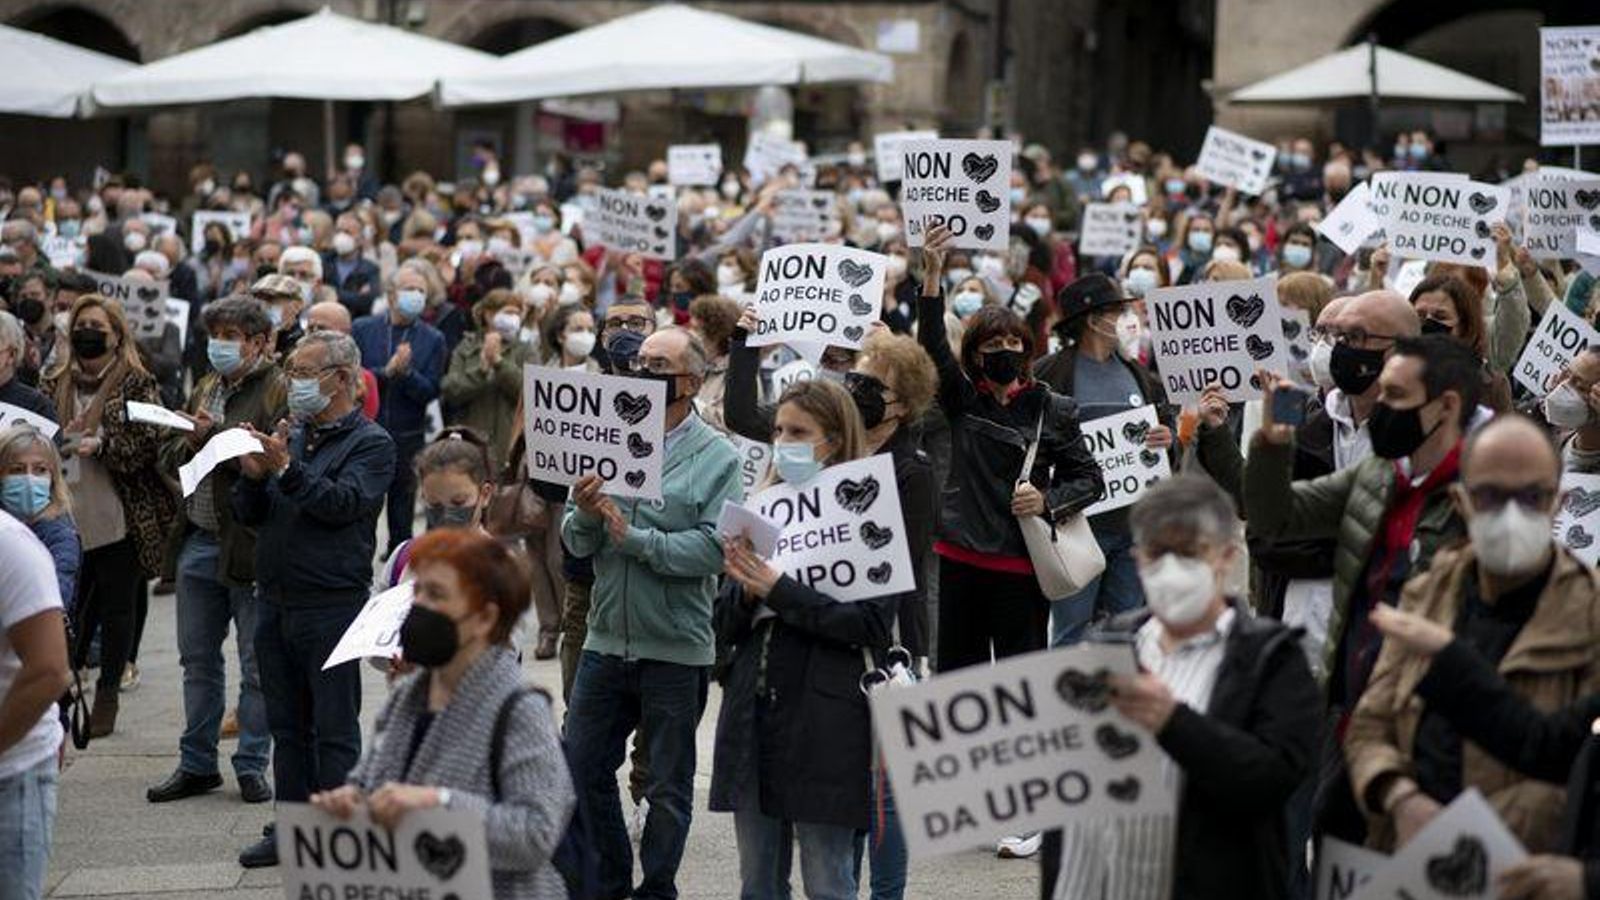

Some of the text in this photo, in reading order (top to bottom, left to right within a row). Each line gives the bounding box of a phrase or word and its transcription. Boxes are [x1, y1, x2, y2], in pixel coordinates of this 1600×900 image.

[905, 152, 951, 179] NON
[601, 194, 638, 217] NON
[921, 186, 970, 203] PECHE
[1404, 183, 1460, 209] NON
[1528, 187, 1567, 209] NON
[1400, 210, 1471, 229] AO PECHE
[1395, 234, 1466, 255] DA UPO
[765, 255, 827, 283] NON
[101, 281, 130, 299] ON
[760, 286, 842, 304] AO PECHE
[757, 311, 837, 335] DA UPO
[1154, 298, 1215, 331] NON
[1161, 334, 1239, 356] AO PECHE
[1536, 340, 1553, 357] AO
[1168, 365, 1241, 393] DA UPO
[1523, 366, 1540, 383] DA
[533, 380, 602, 417] NON
[533, 417, 621, 445] AO PECHE
[1083, 428, 1115, 453] ON
[535, 451, 618, 481] DA UPO
[1097, 452, 1135, 473] ECHE
[761, 488, 821, 527] ON
[777, 523, 852, 556] PECHE
[899, 679, 1037, 748] NON
[912, 724, 1084, 786] AO PECHE
[923, 770, 1091, 840] DA UPO
[294, 826, 397, 872] NON
